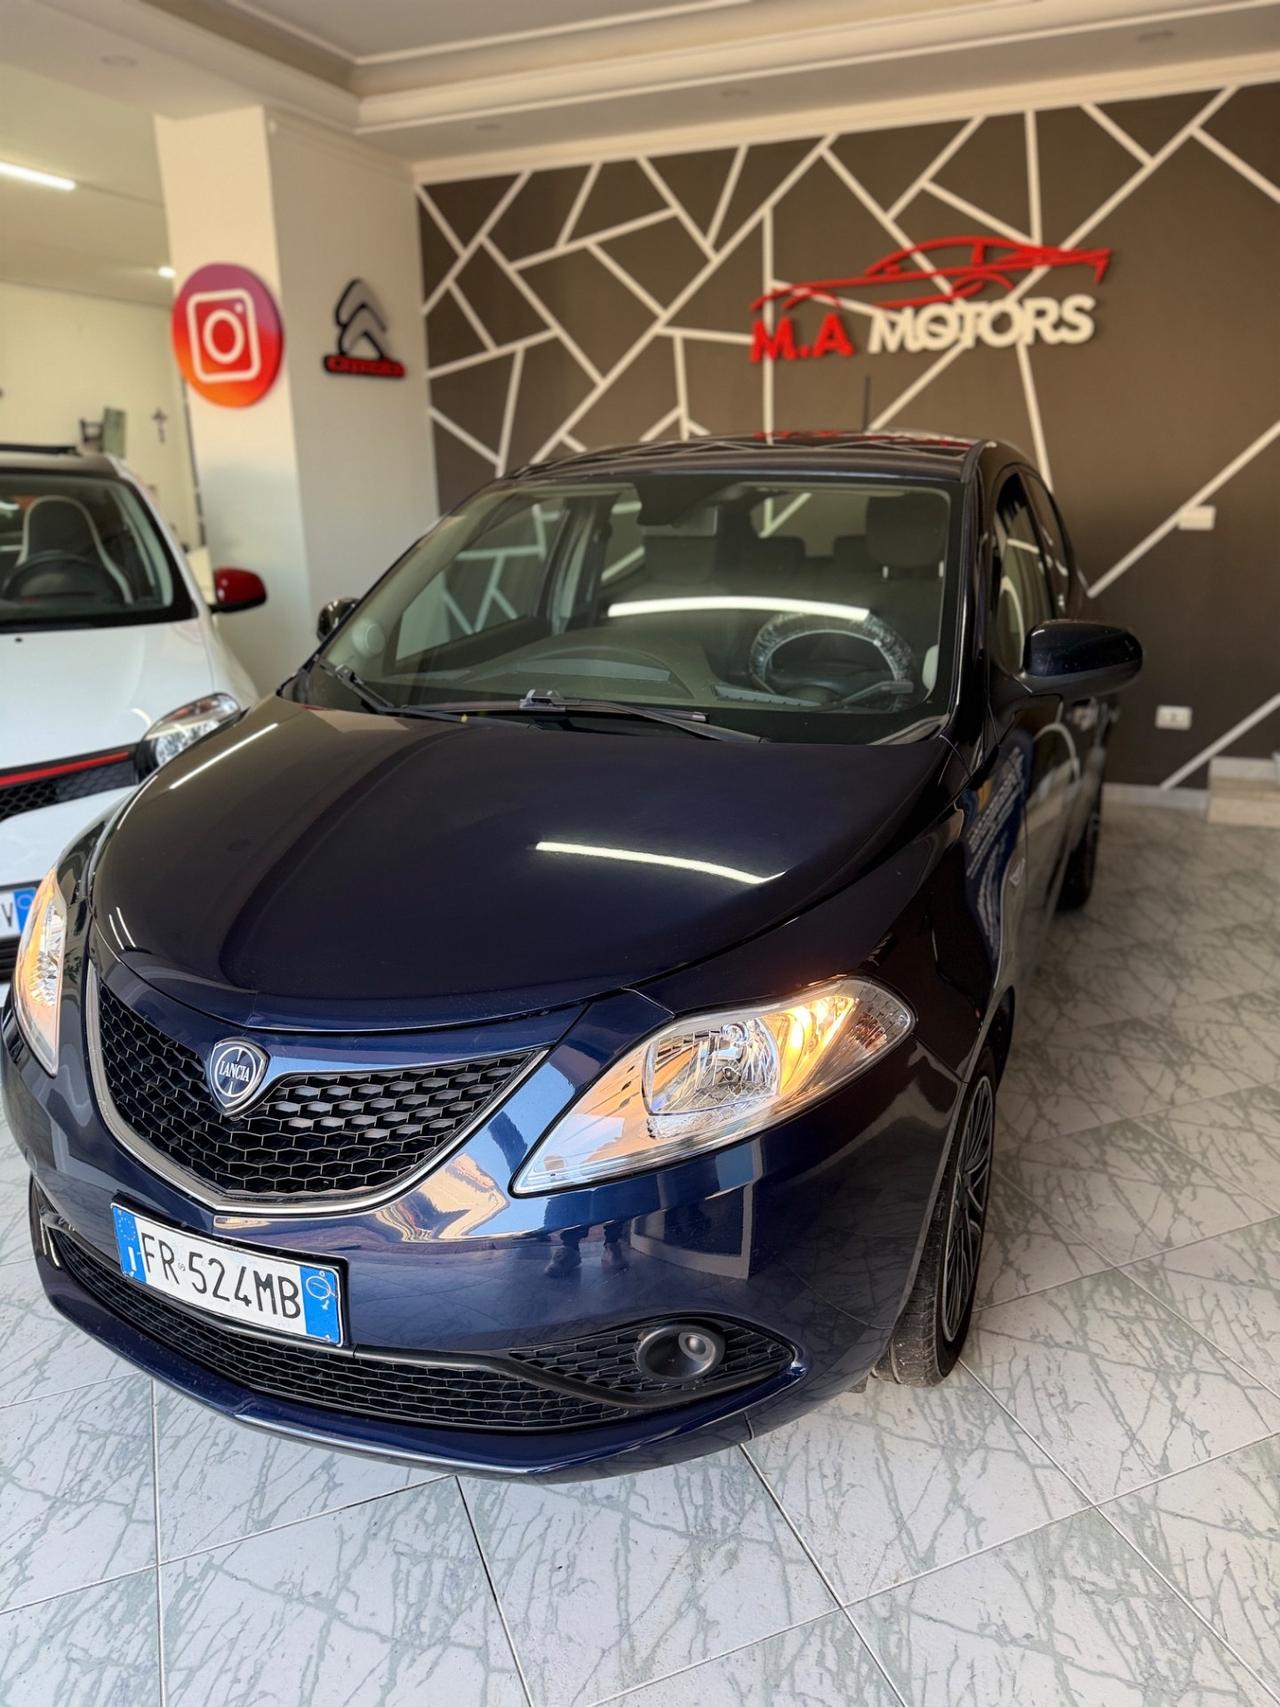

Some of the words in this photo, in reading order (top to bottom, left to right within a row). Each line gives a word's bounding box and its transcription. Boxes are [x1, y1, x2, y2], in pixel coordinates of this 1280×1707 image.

[750, 312, 854, 363] M.A
[868, 294, 1096, 354] MOTORS
[219, 1060, 250, 1082] LANCIA
